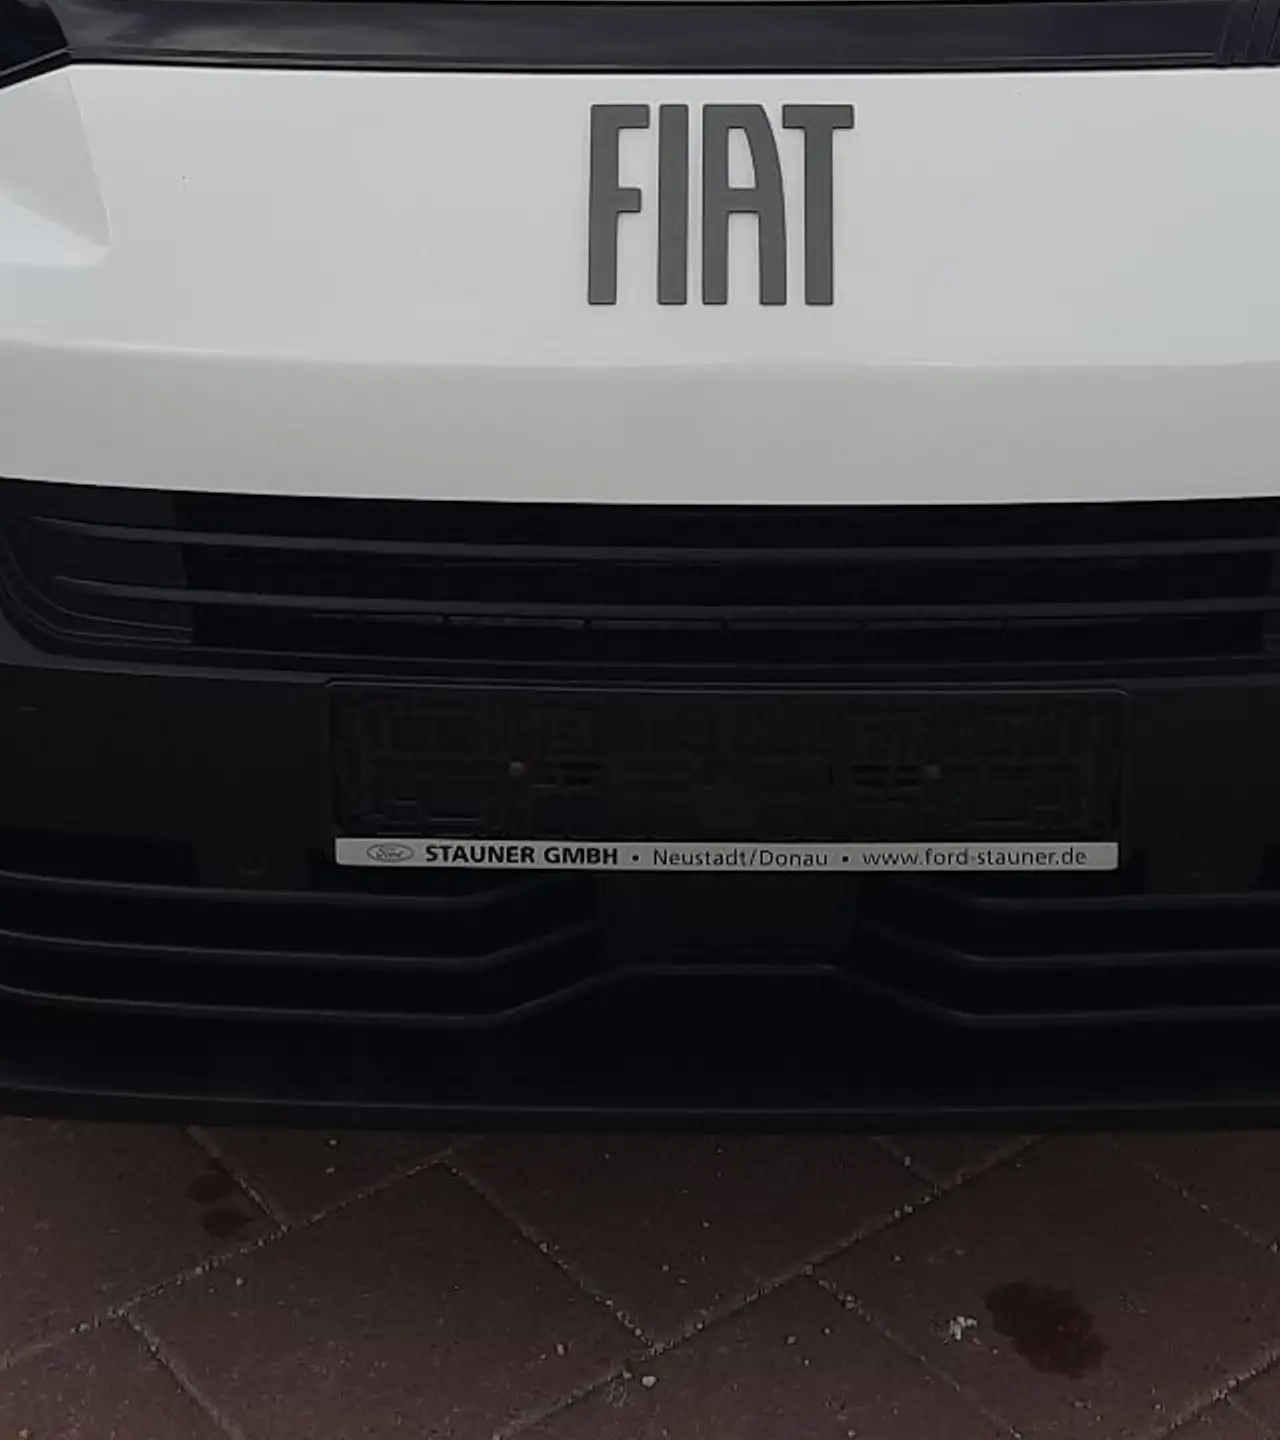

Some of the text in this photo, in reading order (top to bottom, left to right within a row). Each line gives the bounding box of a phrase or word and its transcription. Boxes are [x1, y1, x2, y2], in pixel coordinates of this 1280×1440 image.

[588, 104, 854, 305] FIAT
[425, 844, 536, 864] STAUNER
[543, 846, 619, 865] GMBH
[653, 847, 829, 867] Neustadt/Donau
[861, 845, 1089, 867] www.ford-stauner.de
